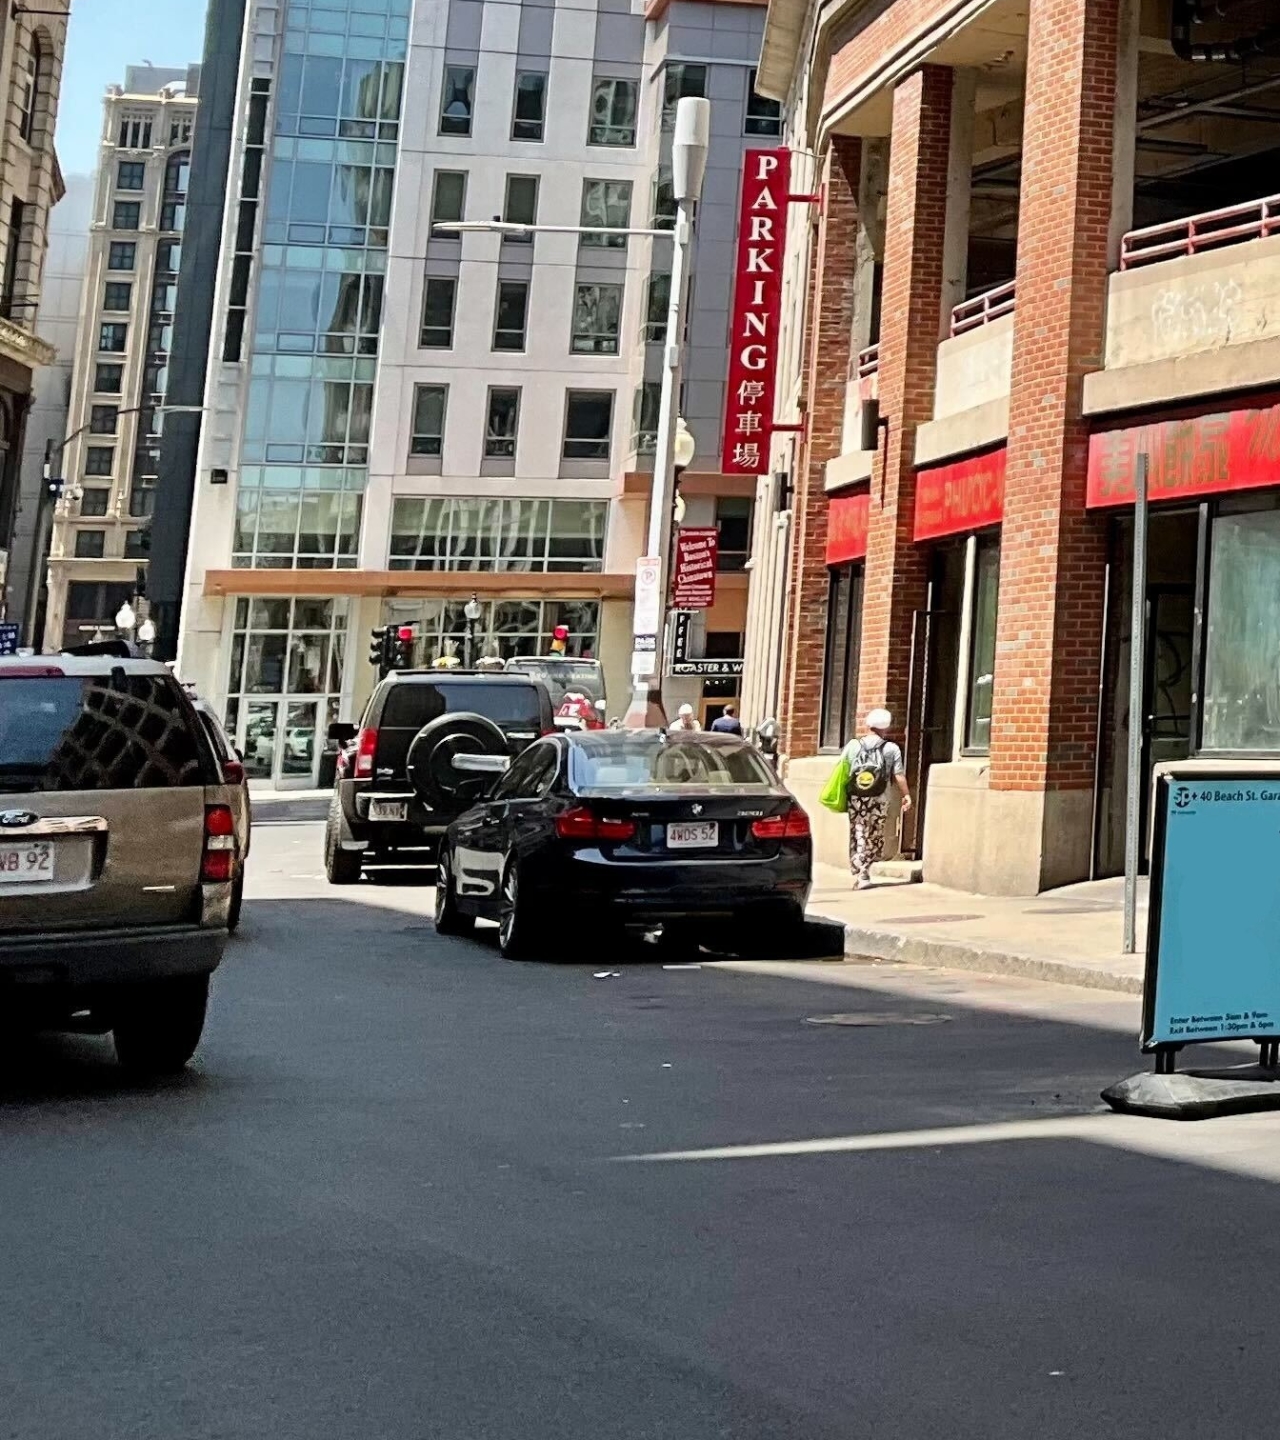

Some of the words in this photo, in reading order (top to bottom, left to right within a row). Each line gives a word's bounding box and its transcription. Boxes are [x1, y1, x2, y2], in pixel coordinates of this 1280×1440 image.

[740, 155, 779, 371] PARKING
[732, 379, 765, 469] 停車場
[1200, 791, 1212, 801] 40
[1214, 790, 1244, 802] Beach
[1245, 790, 1259, 802] St.
[670, 828, 698, 841] 4WDS
[700, 827, 716, 840] 52
[26, 851, 49, 870] 92
[1170, 1016, 1189, 1025] Enter
[1191, 1014, 1223, 1023] Between
[1169, 1026, 1184, 1035] Exit
[1186, 1024, 1218, 1033] Between
[1220, 1022, 1248, 1032] 1:30pm
[1258, 1020, 1274, 1030] 6pm
